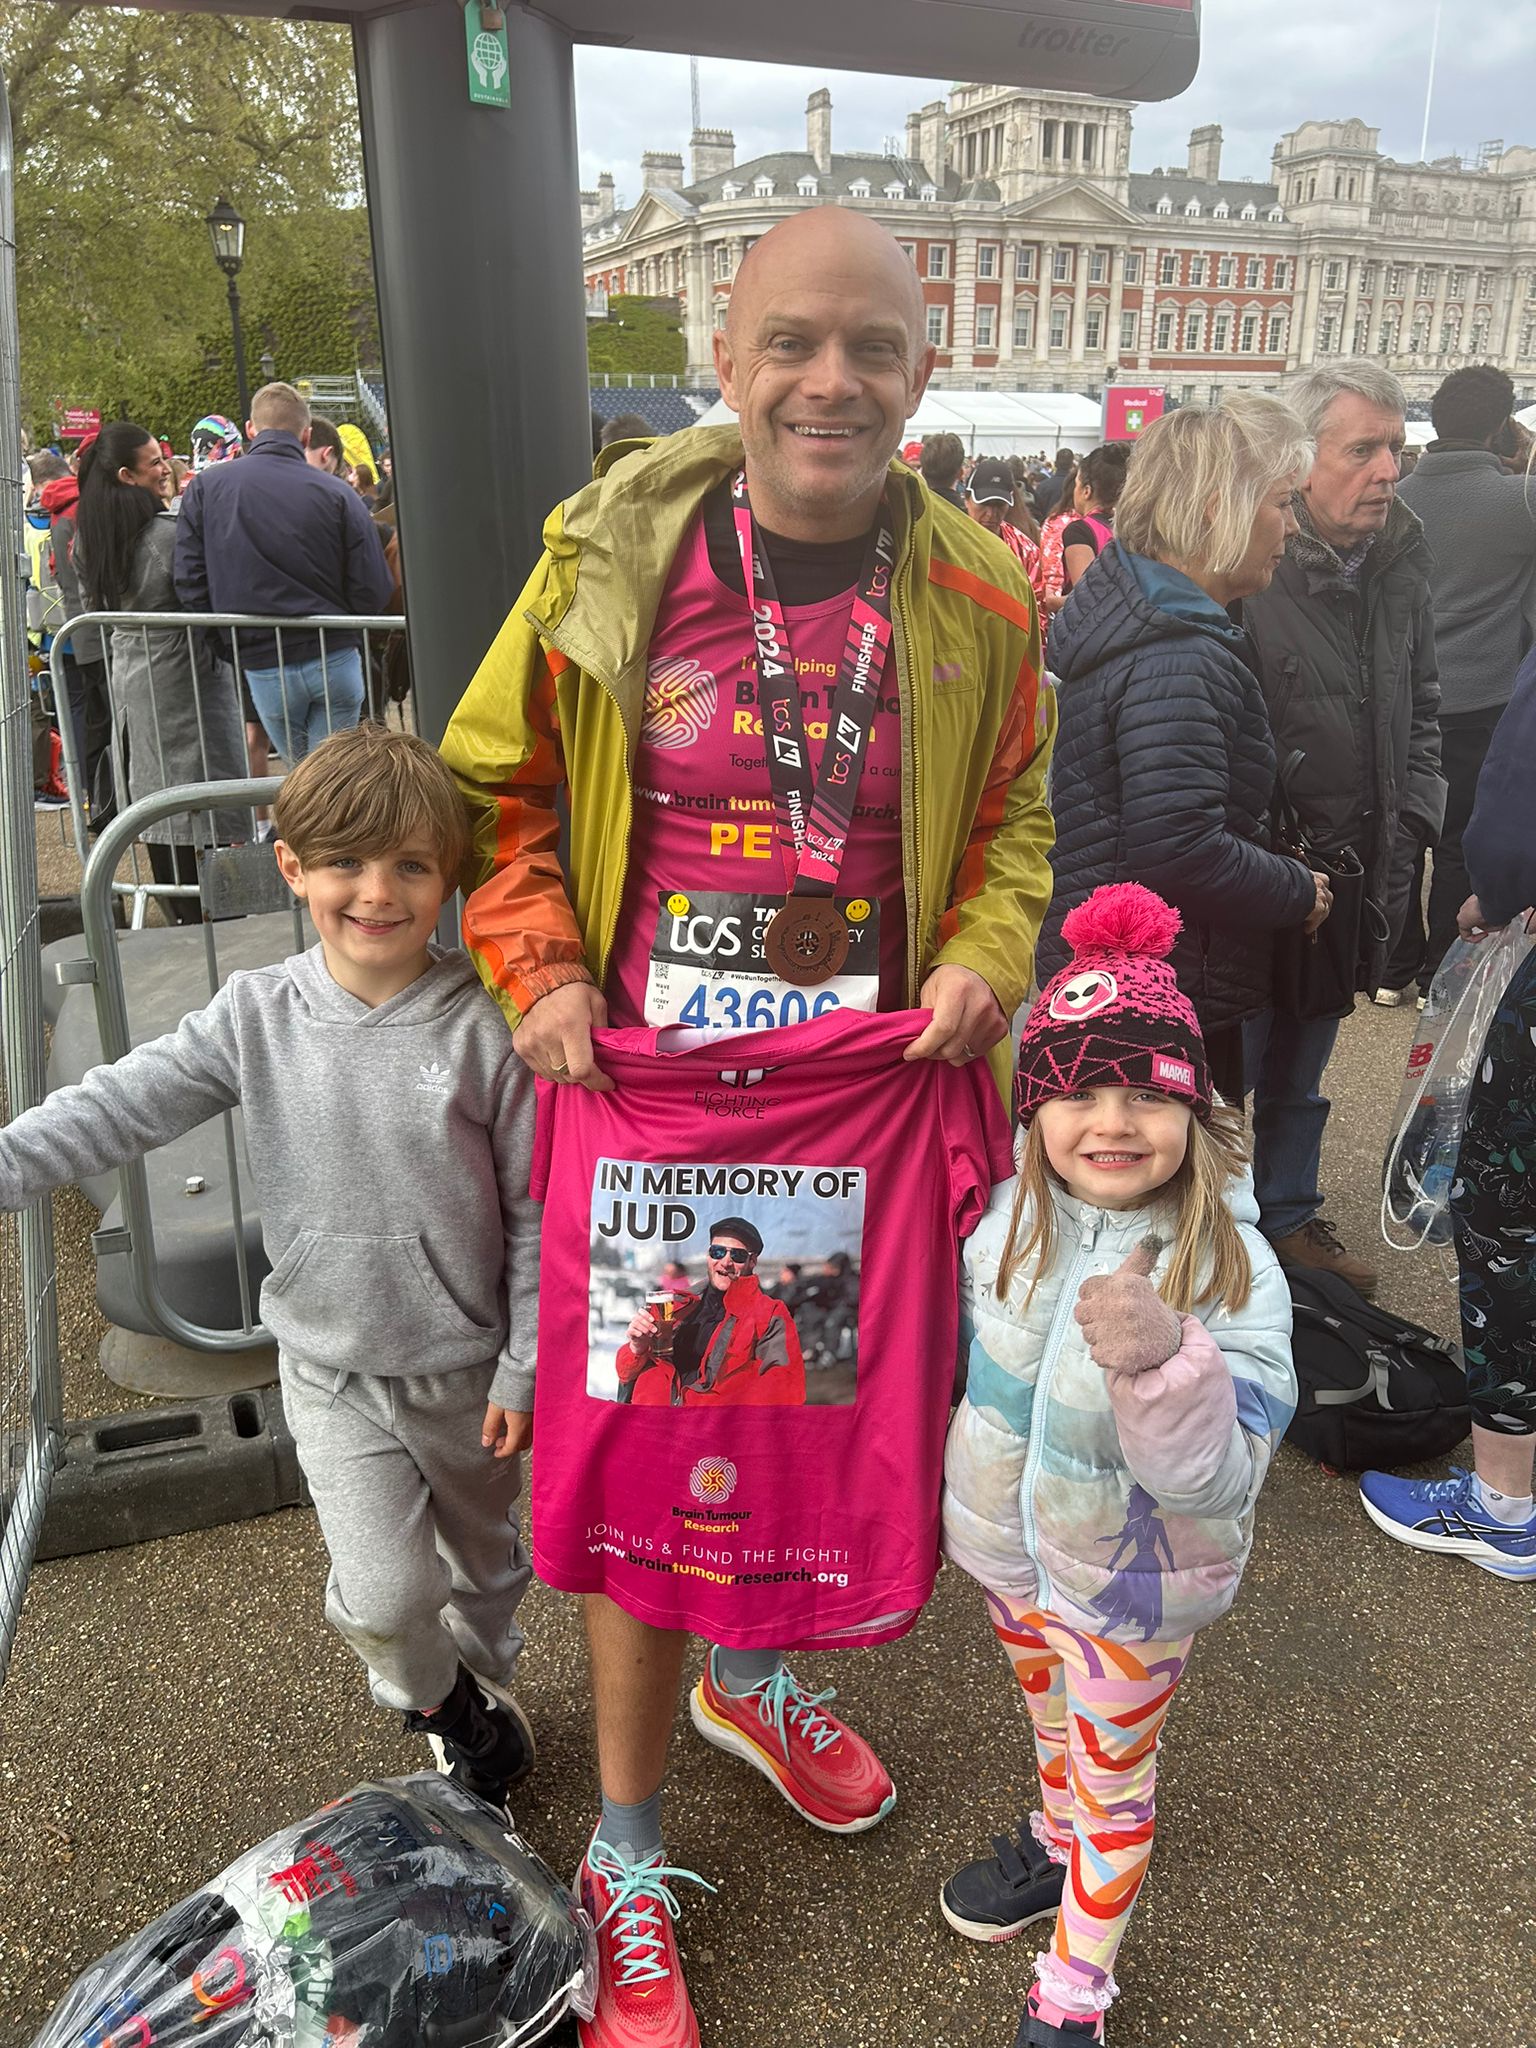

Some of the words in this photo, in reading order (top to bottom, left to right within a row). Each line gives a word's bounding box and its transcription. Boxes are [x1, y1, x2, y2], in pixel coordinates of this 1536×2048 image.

[1017, 21, 1130, 58] trotter
[754, 605, 785, 679] 2024
[852, 622, 878, 694] FINISHER
[772, 698, 791, 732] tcs
[827, 752, 852, 785] tcs
[810, 850, 835, 863] 2024
[669, 914, 742, 957] tcs
[1159, 1061, 1191, 1086] MARVEL
[694, 1090, 781, 1107] FIGHTING
[705, 1104, 767, 1120] FORCE
[599, 1162, 634, 1193] IN
[641, 1166, 805, 1198] MEMORY
[812, 1170, 861, 1199] OF
[597, 1199, 697, 1242] JUD
[672, 1507, 704, 1521] Brain
[706, 1509, 752, 1521] Tumour
[684, 1520, 739, 1533] Research
[586, 1523, 624, 1542] JOIN
[632, 1535, 653, 1551] US
[661, 1542, 672, 1555] &
[683, 1544, 733, 1565] FUND
[742, 1550, 776, 1564] THE
[785, 1547, 849, 1564] FIGHT!
[588, 1541, 849, 1588] www.braintumourresearch.org
